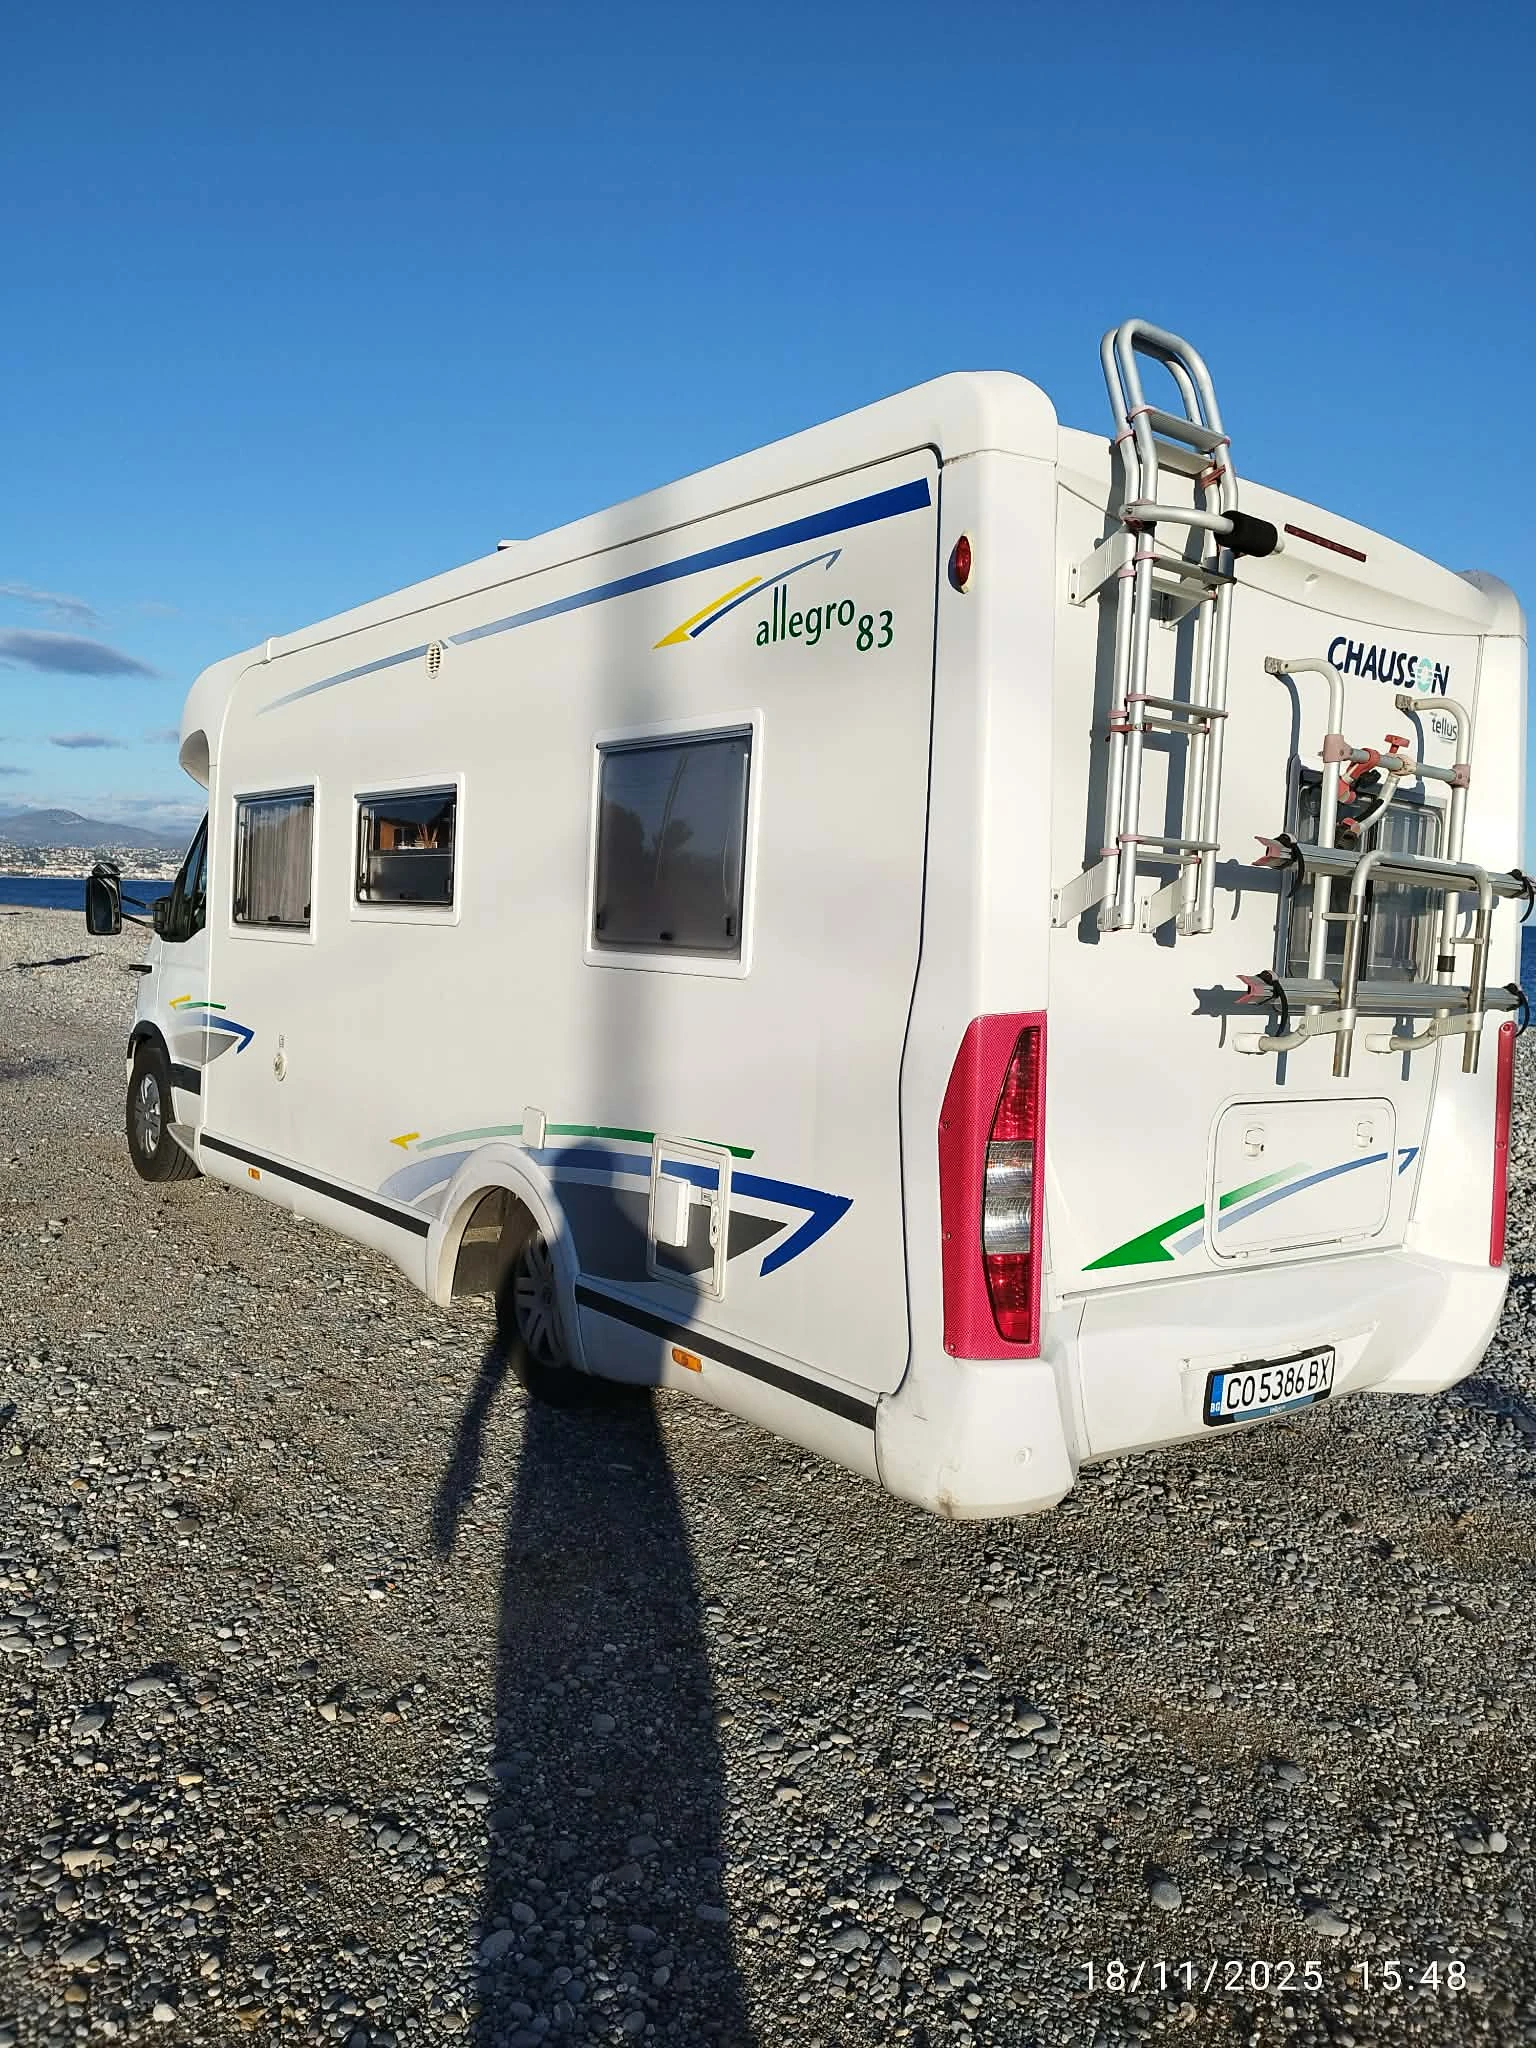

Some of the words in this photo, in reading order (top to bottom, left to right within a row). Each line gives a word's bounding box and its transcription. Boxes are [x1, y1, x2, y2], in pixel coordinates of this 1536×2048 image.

[756, 584, 855, 646] allegro
[856, 610, 894, 651] 83
[1327, 636, 1450, 696] CHAUSSON
[1226, 1375, 1256, 1410] CO
[1259, 1363, 1305, 1403] 5386
[1307, 1355, 1330, 1392] BX
